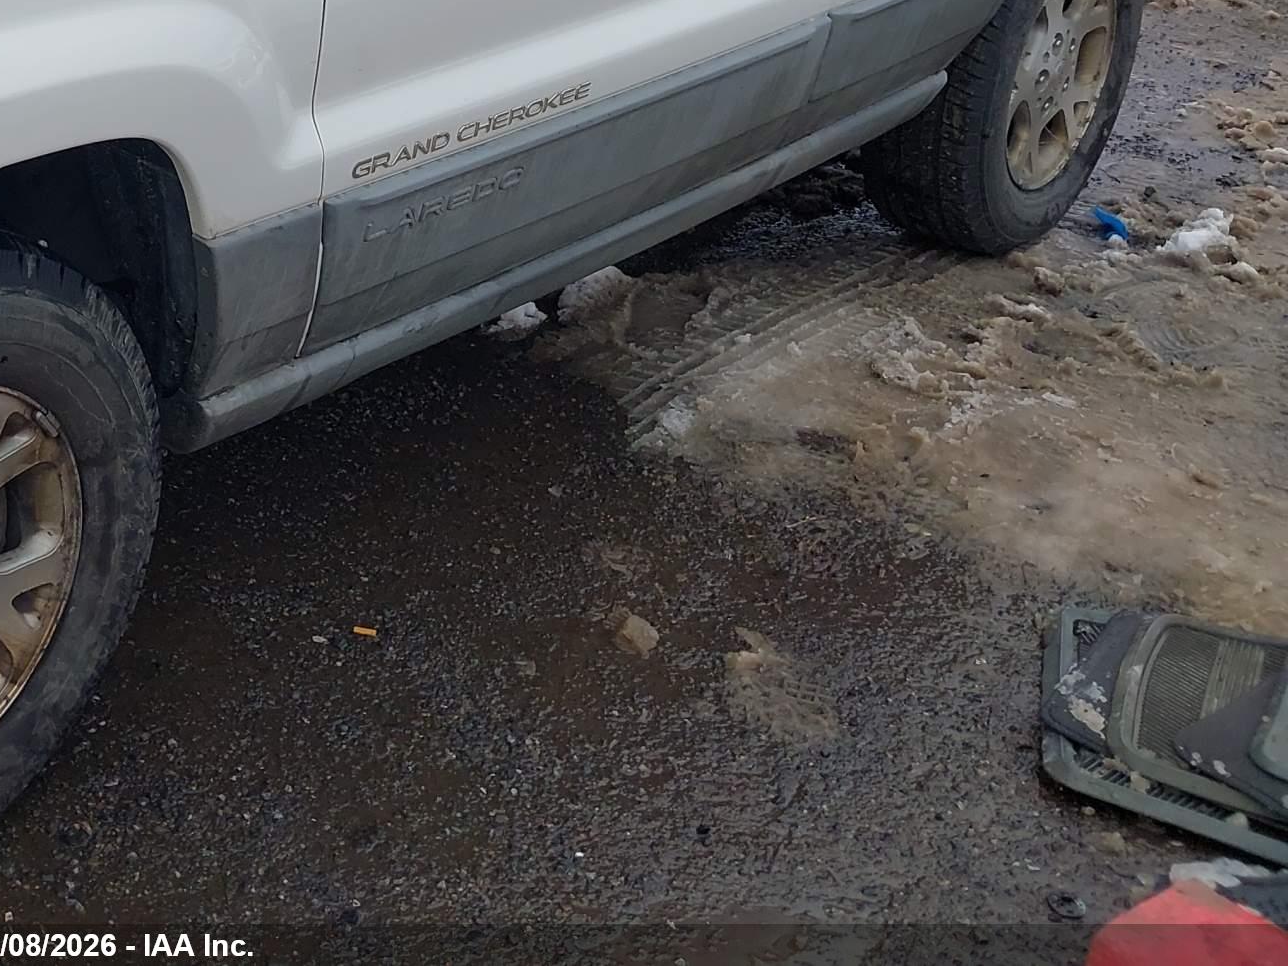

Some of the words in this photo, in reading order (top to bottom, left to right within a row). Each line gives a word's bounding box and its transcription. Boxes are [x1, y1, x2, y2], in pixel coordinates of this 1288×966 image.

[352, 133, 450, 179] GRAND
[457, 81, 592, 143] CHEROKEE
[363, 166, 524, 243] LAREDO
